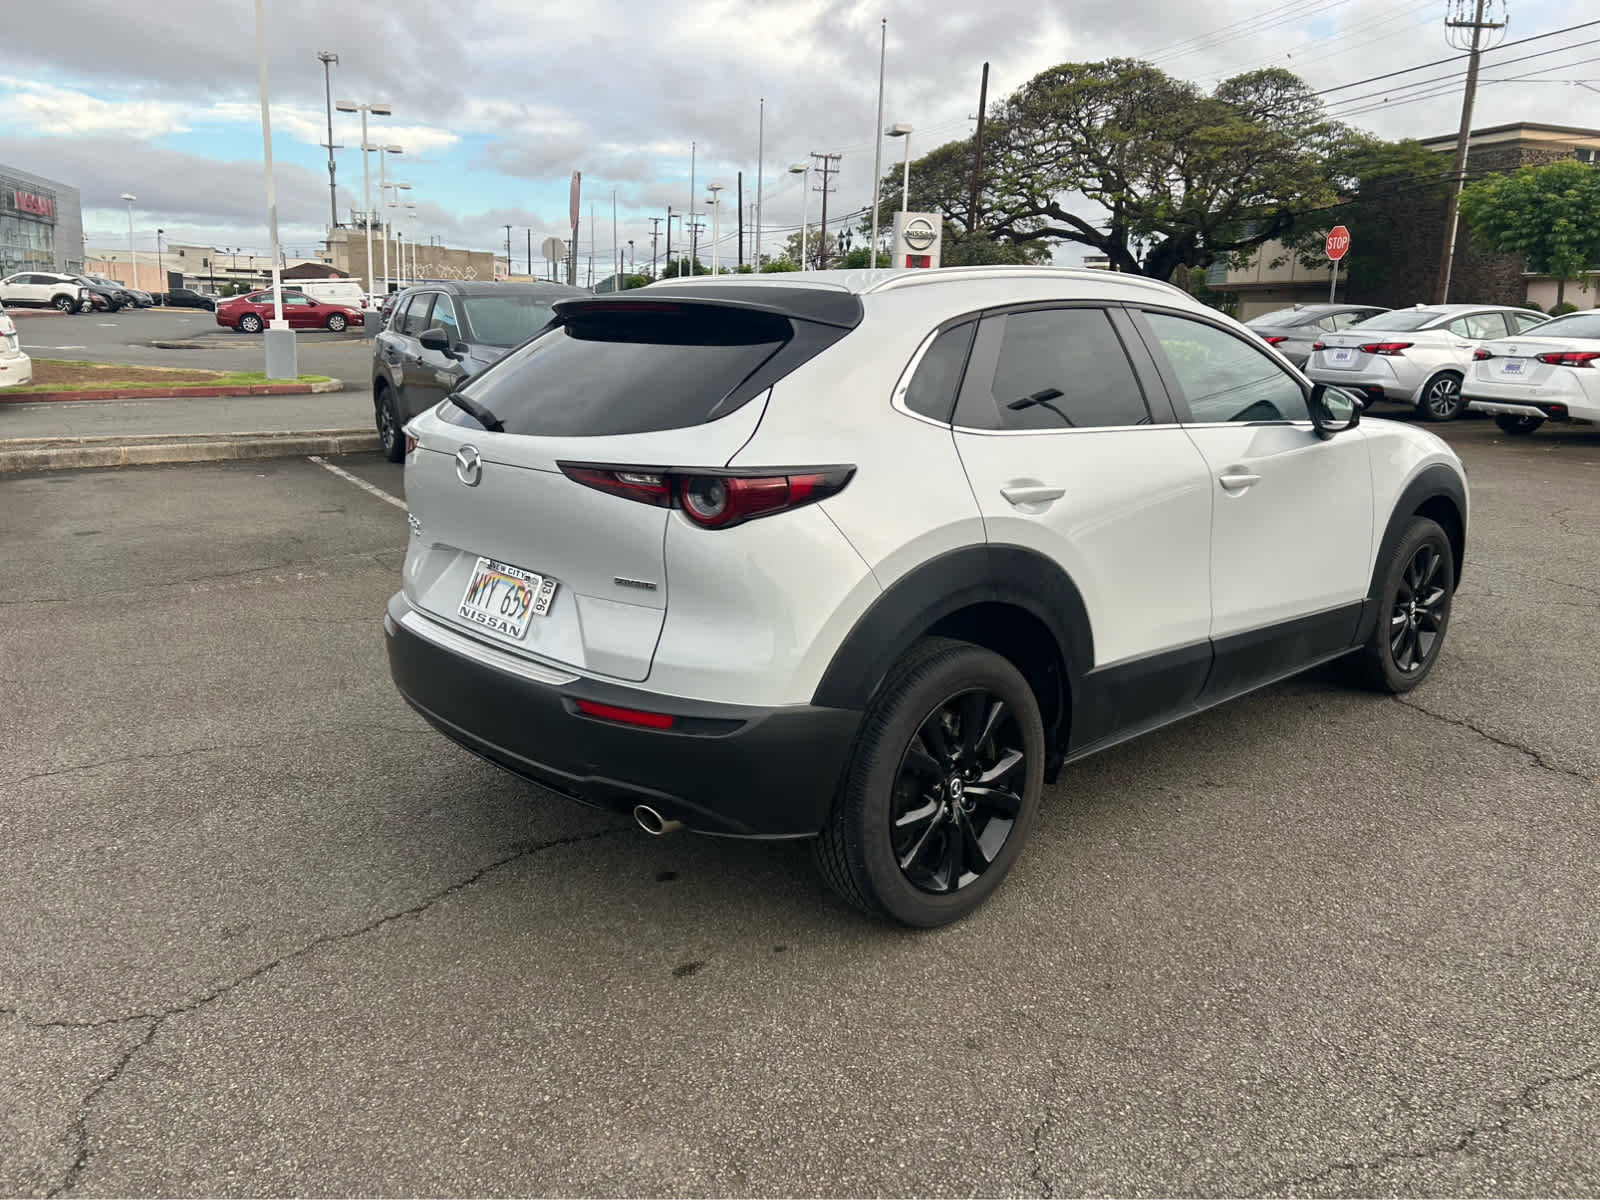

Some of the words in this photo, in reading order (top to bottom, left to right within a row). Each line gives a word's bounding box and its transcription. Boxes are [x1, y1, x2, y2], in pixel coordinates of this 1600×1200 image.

[15, 191, 54, 217] NISSAN
[1327, 236, 1348, 250] STOP
[507, 567, 525, 578] CITY
[542, 580, 554, 595] 03
[500, 585, 533, 619] 659
[535, 598, 548, 612] 26
[459, 606, 521, 636] NISSAN
